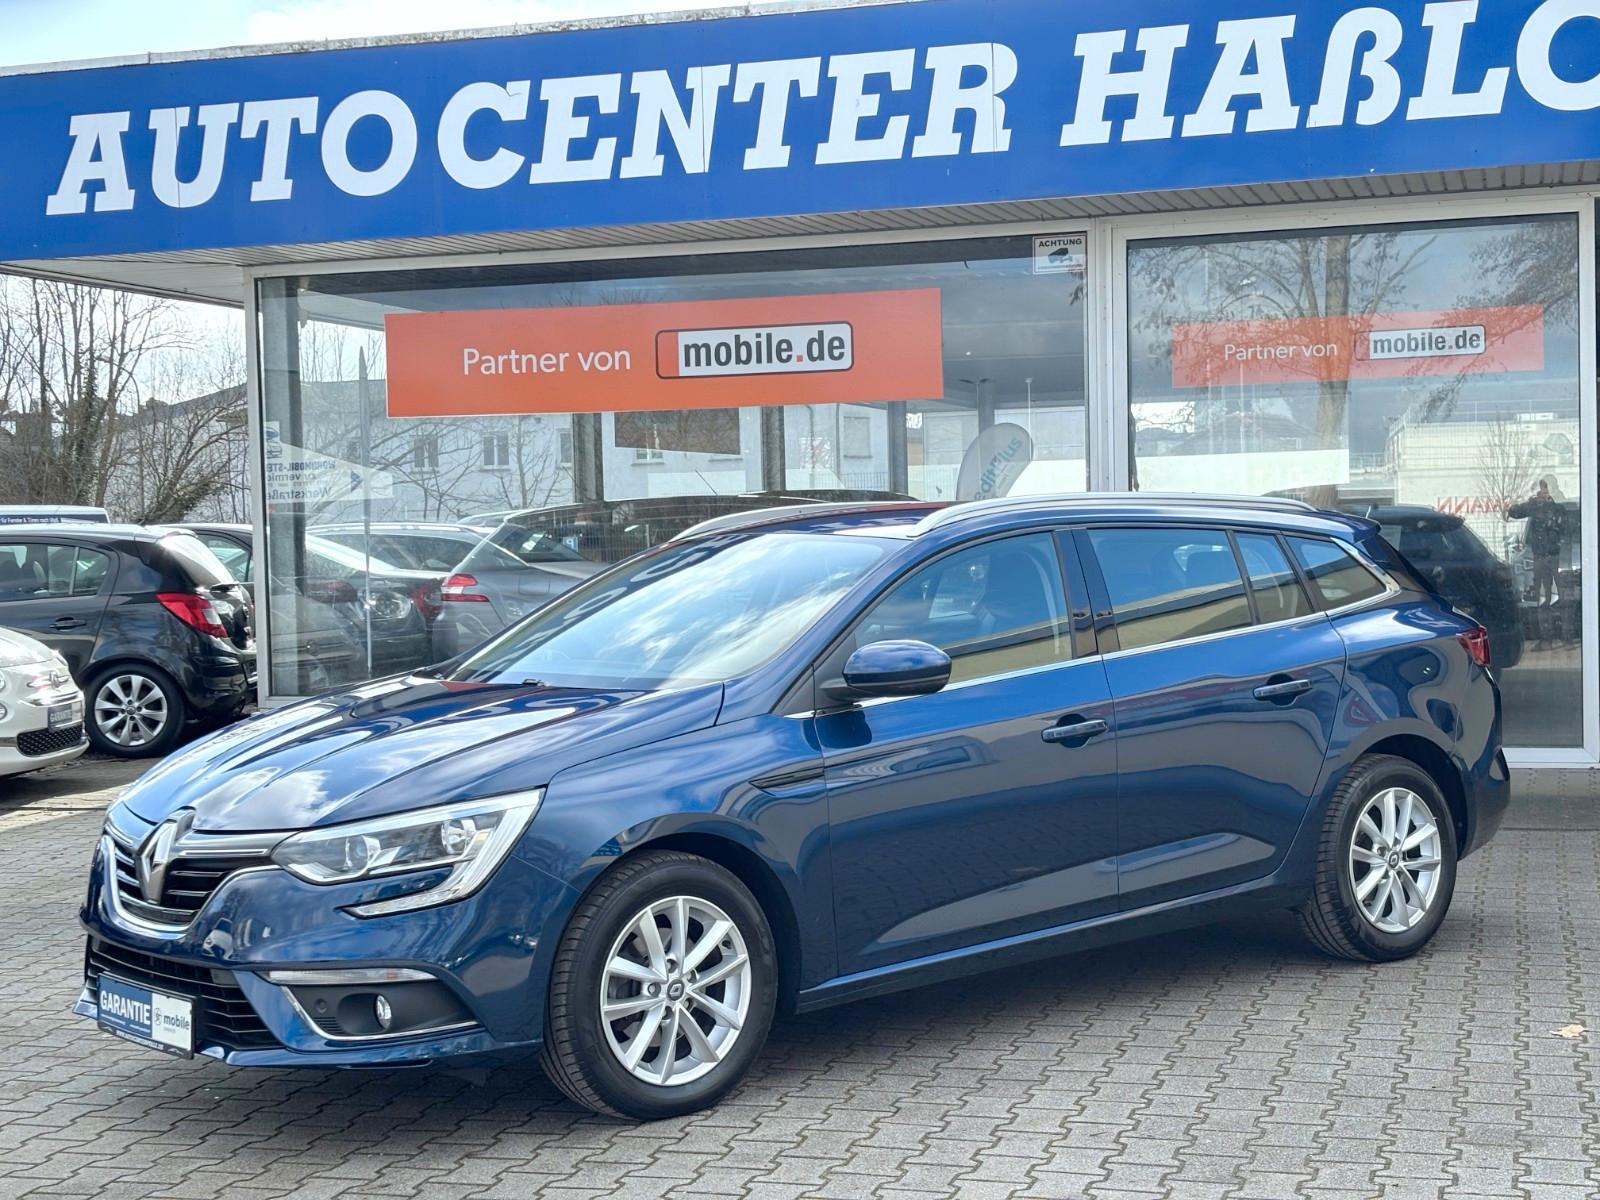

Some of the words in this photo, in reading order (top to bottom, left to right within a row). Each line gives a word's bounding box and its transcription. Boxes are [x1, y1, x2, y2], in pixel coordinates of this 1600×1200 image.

[1038, 238, 1083, 248] ACHTUNG
[462, 347, 570, 376] Partner
[577, 349, 632, 372] von
[683, 329, 846, 368] mobile.de
[1223, 343, 1298, 361] Partner
[1302, 342, 1339, 358] von
[1372, 329, 1481, 354] mobile.de
[100, 990, 151, 1026] GARANTIE
[163, 1013, 190, 1031] mobile
